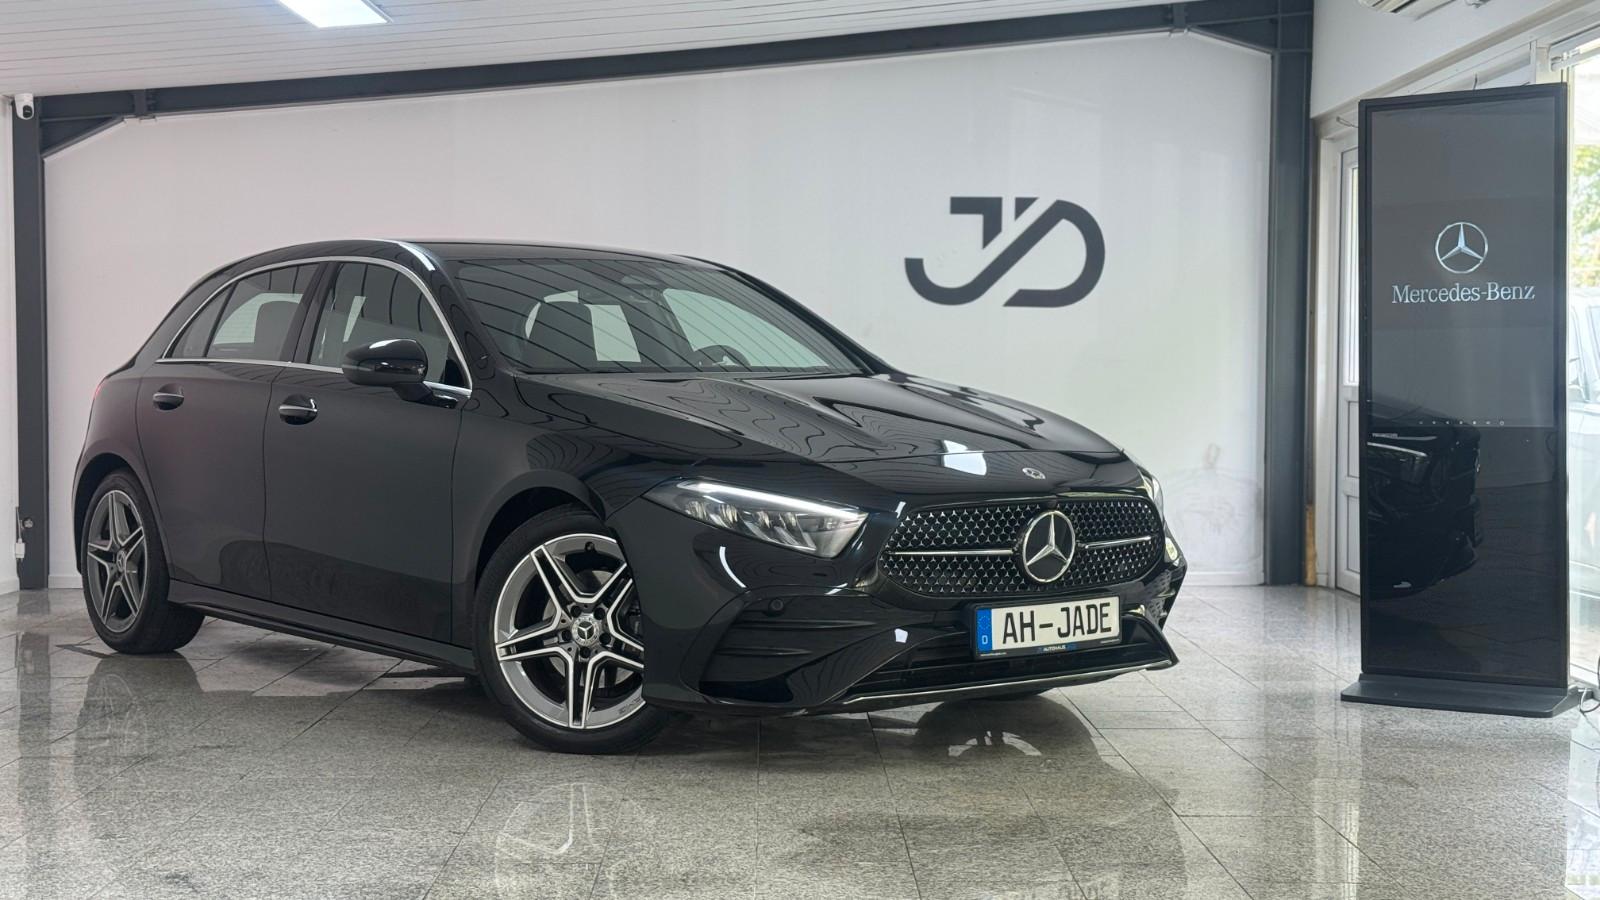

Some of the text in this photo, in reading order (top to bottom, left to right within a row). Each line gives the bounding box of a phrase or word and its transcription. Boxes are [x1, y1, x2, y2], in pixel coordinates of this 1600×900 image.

[1391, 282, 1536, 304] Mercedes-Benz
[1002, 602, 1112, 645] AH-JADE
[981, 634, 989, 645] D
